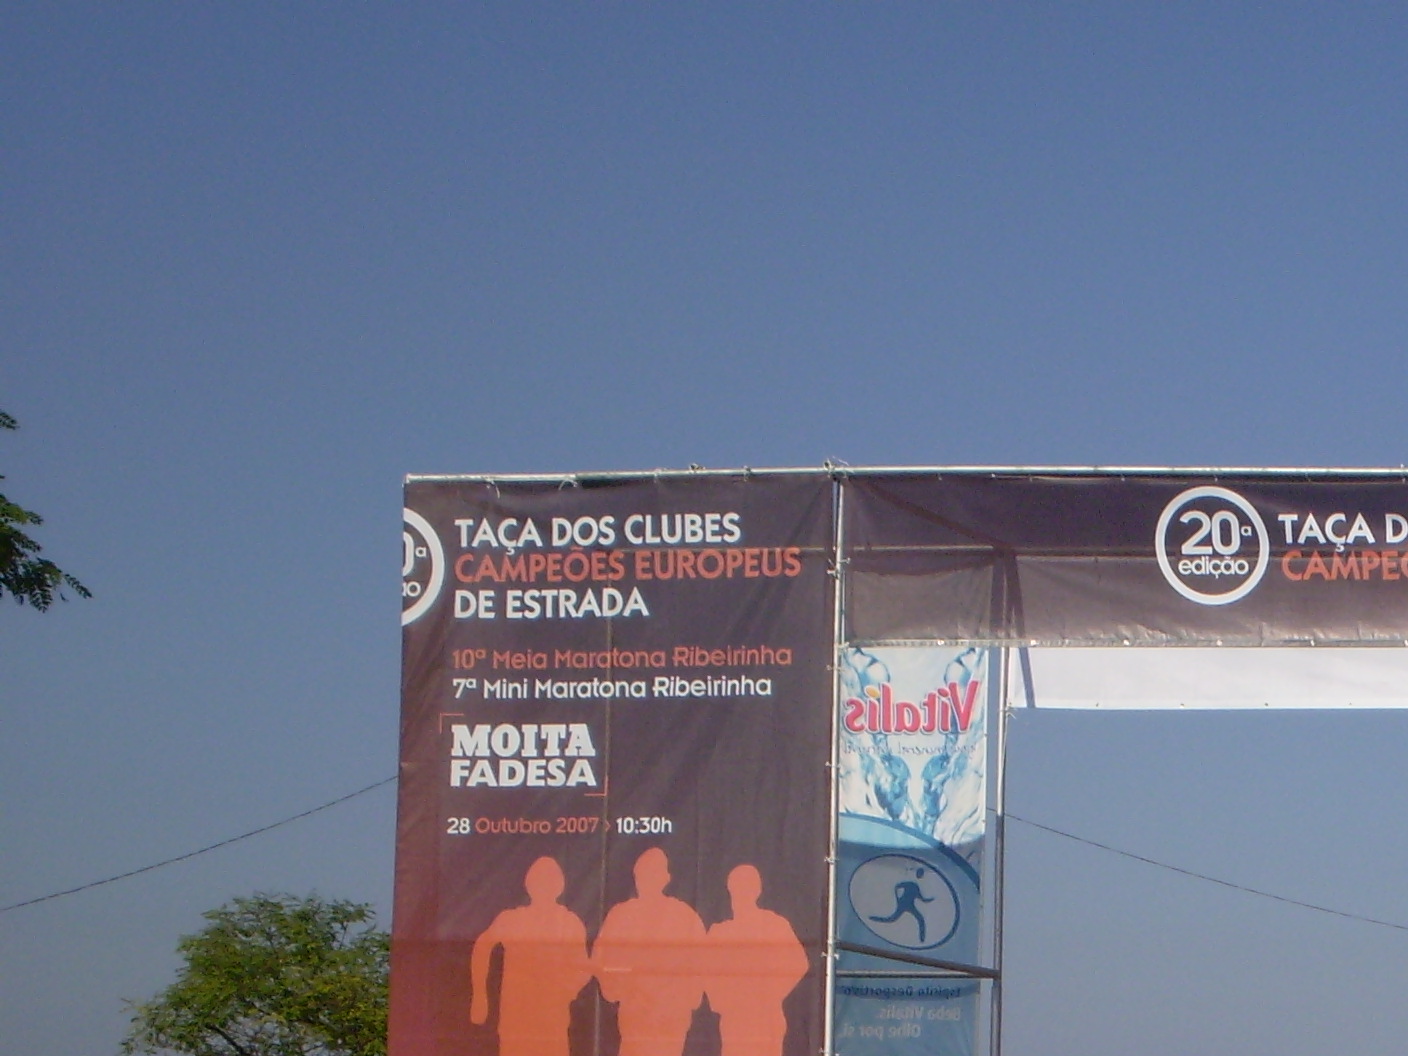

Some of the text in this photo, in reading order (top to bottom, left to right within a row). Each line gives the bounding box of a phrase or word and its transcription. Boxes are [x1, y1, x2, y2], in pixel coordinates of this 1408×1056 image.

[455, 519, 543, 555] TAÇA
[552, 517, 615, 545] DOS
[624, 513, 740, 543] CLUBES
[1278, 513, 1375, 551] TAÇA
[454, 546, 625, 583] CAMPEÕES
[635, 547, 801, 580] EUROPEUS
[1178, 556, 1249, 579] edição
[454, 587, 650, 619] DE ESTRADA
[493, 648, 547, 670] Meia
[555, 647, 666, 669] Maratona
[672, 645, 792, 667] Ribeirinha
[484, 678, 528, 699] Mini
[535, 676, 646, 698] Maratona
[652, 675, 772, 697] Ribeirinha
[450, 723, 596, 756] MOITA
[450, 760, 596, 787] FADESA
[447, 817, 672, 834] 28 Outubro 2007 10:30h
